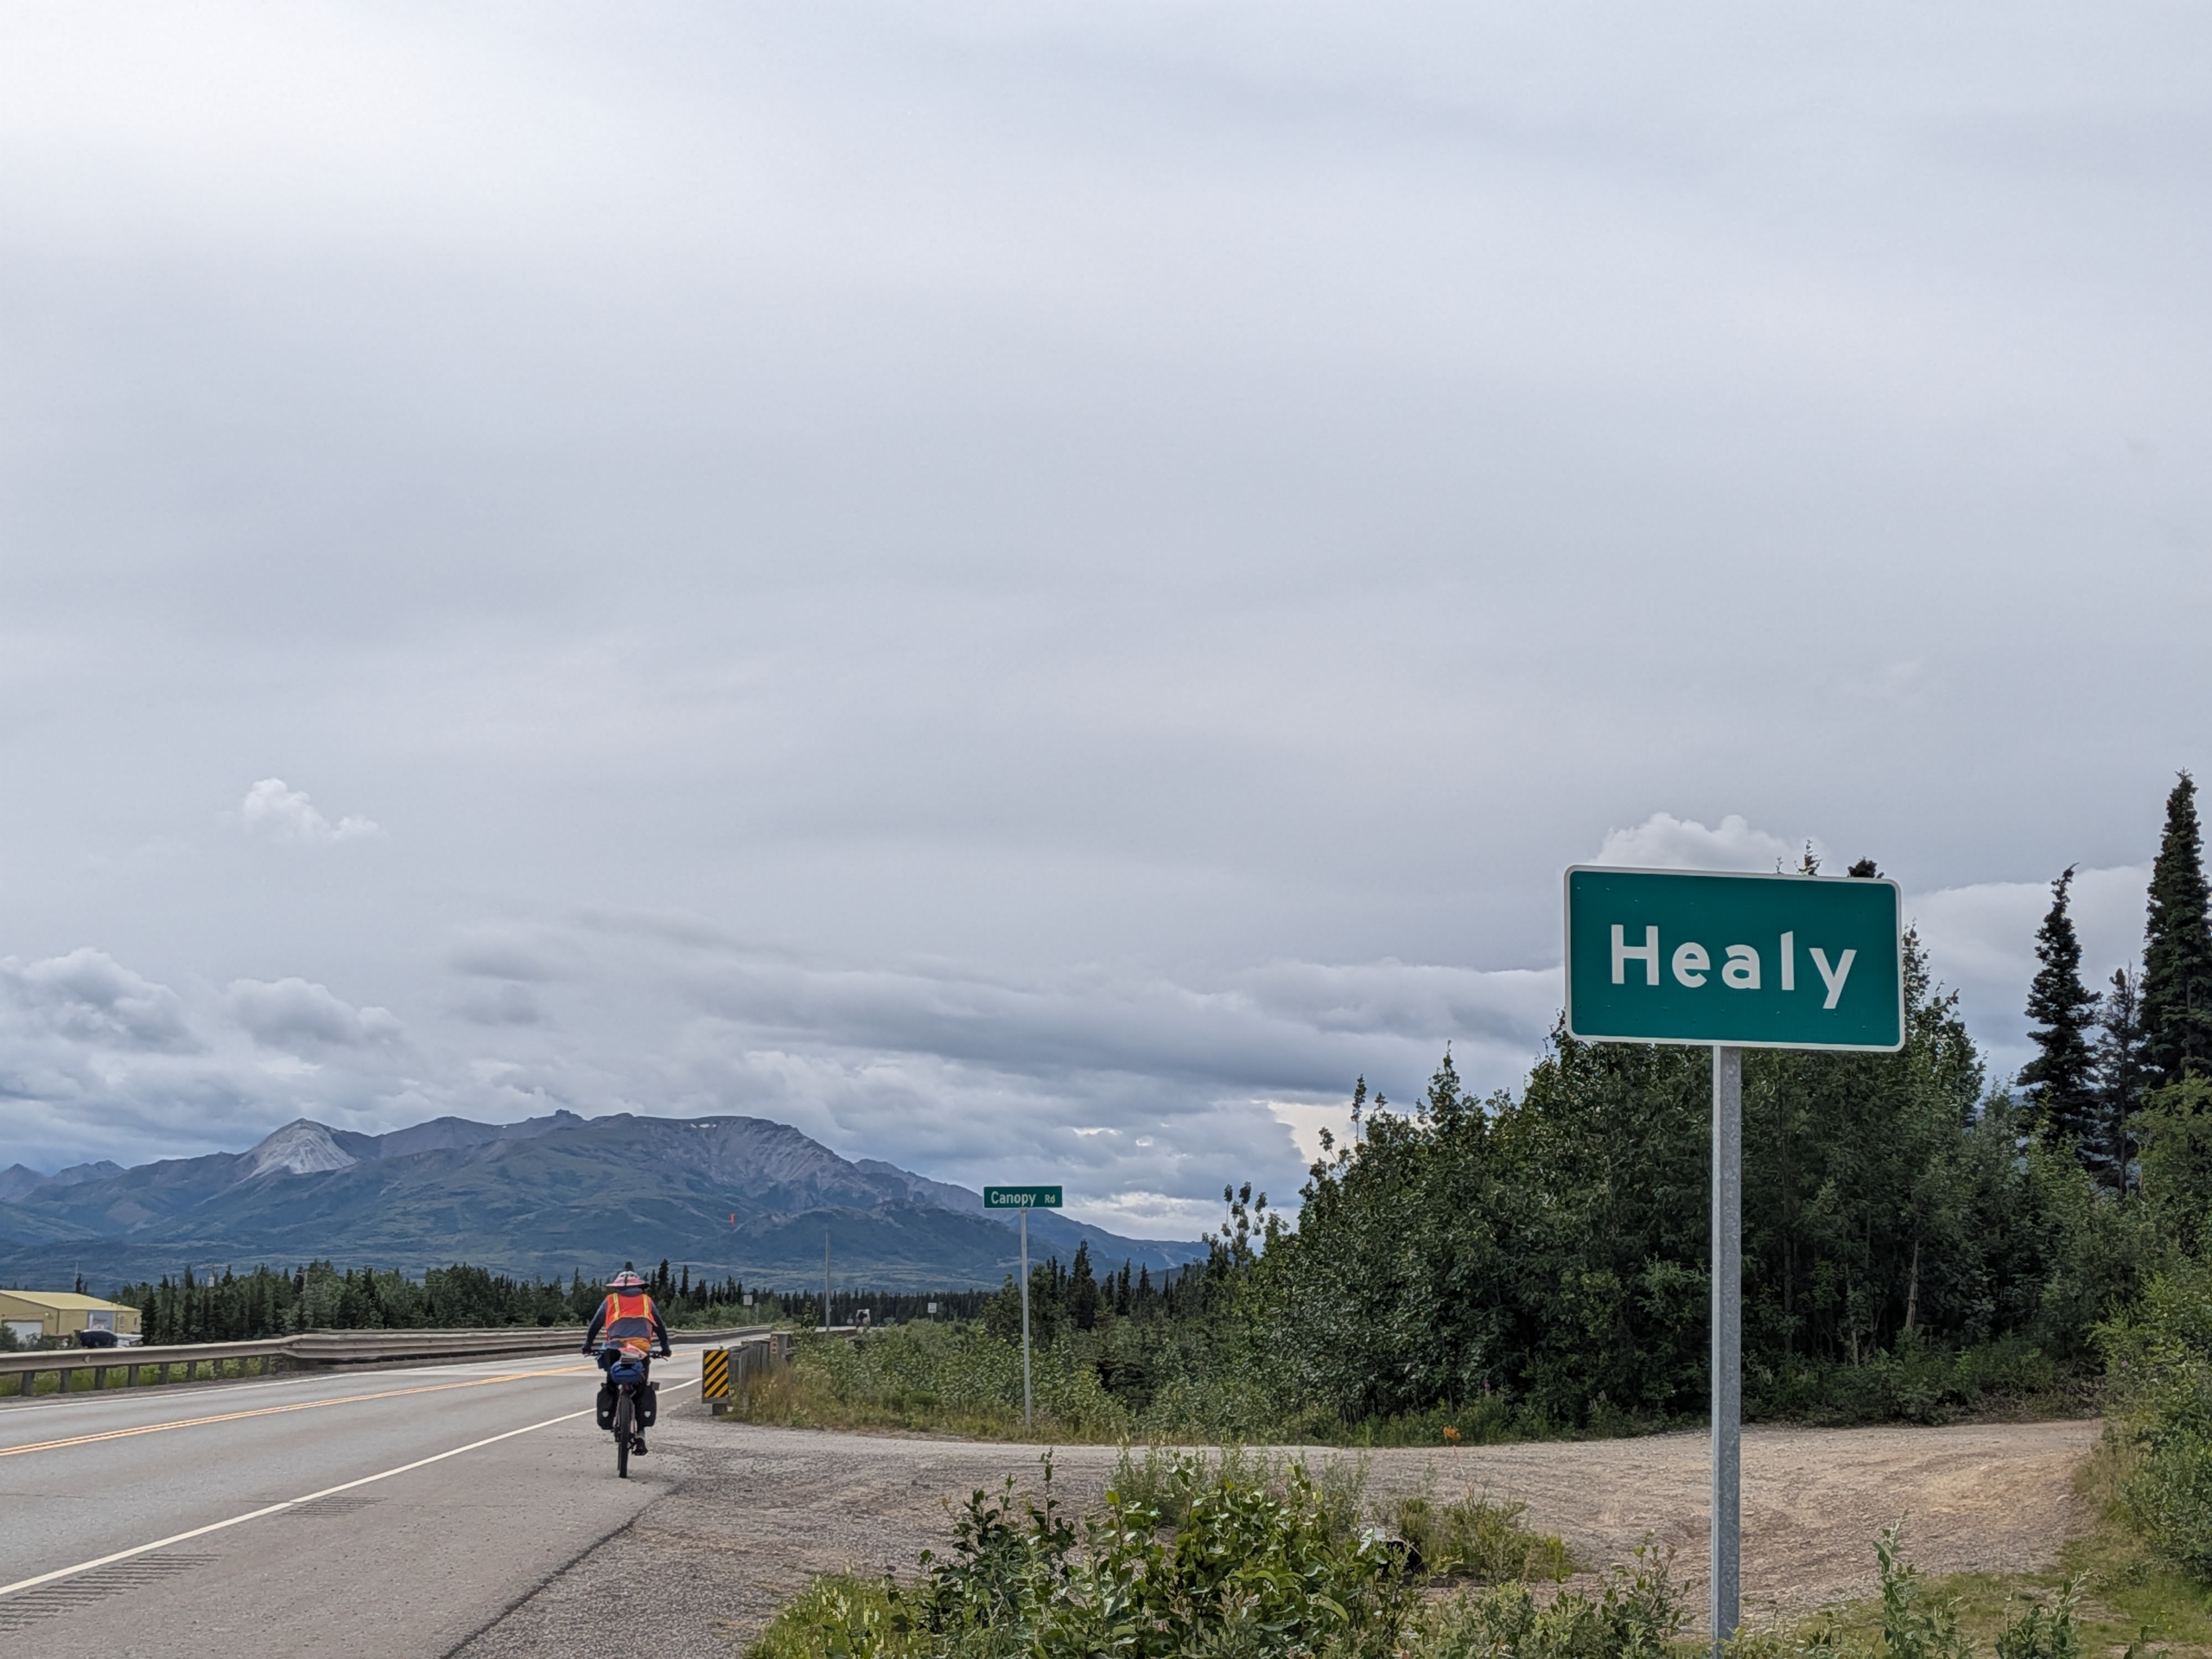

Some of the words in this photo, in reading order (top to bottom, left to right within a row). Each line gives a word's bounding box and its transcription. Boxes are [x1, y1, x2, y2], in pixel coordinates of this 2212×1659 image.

[1611, 924, 1858, 1009] Healy
[990, 1191, 1036, 1206] Canopy
[1044, 1194, 1055, 1204] Rd
